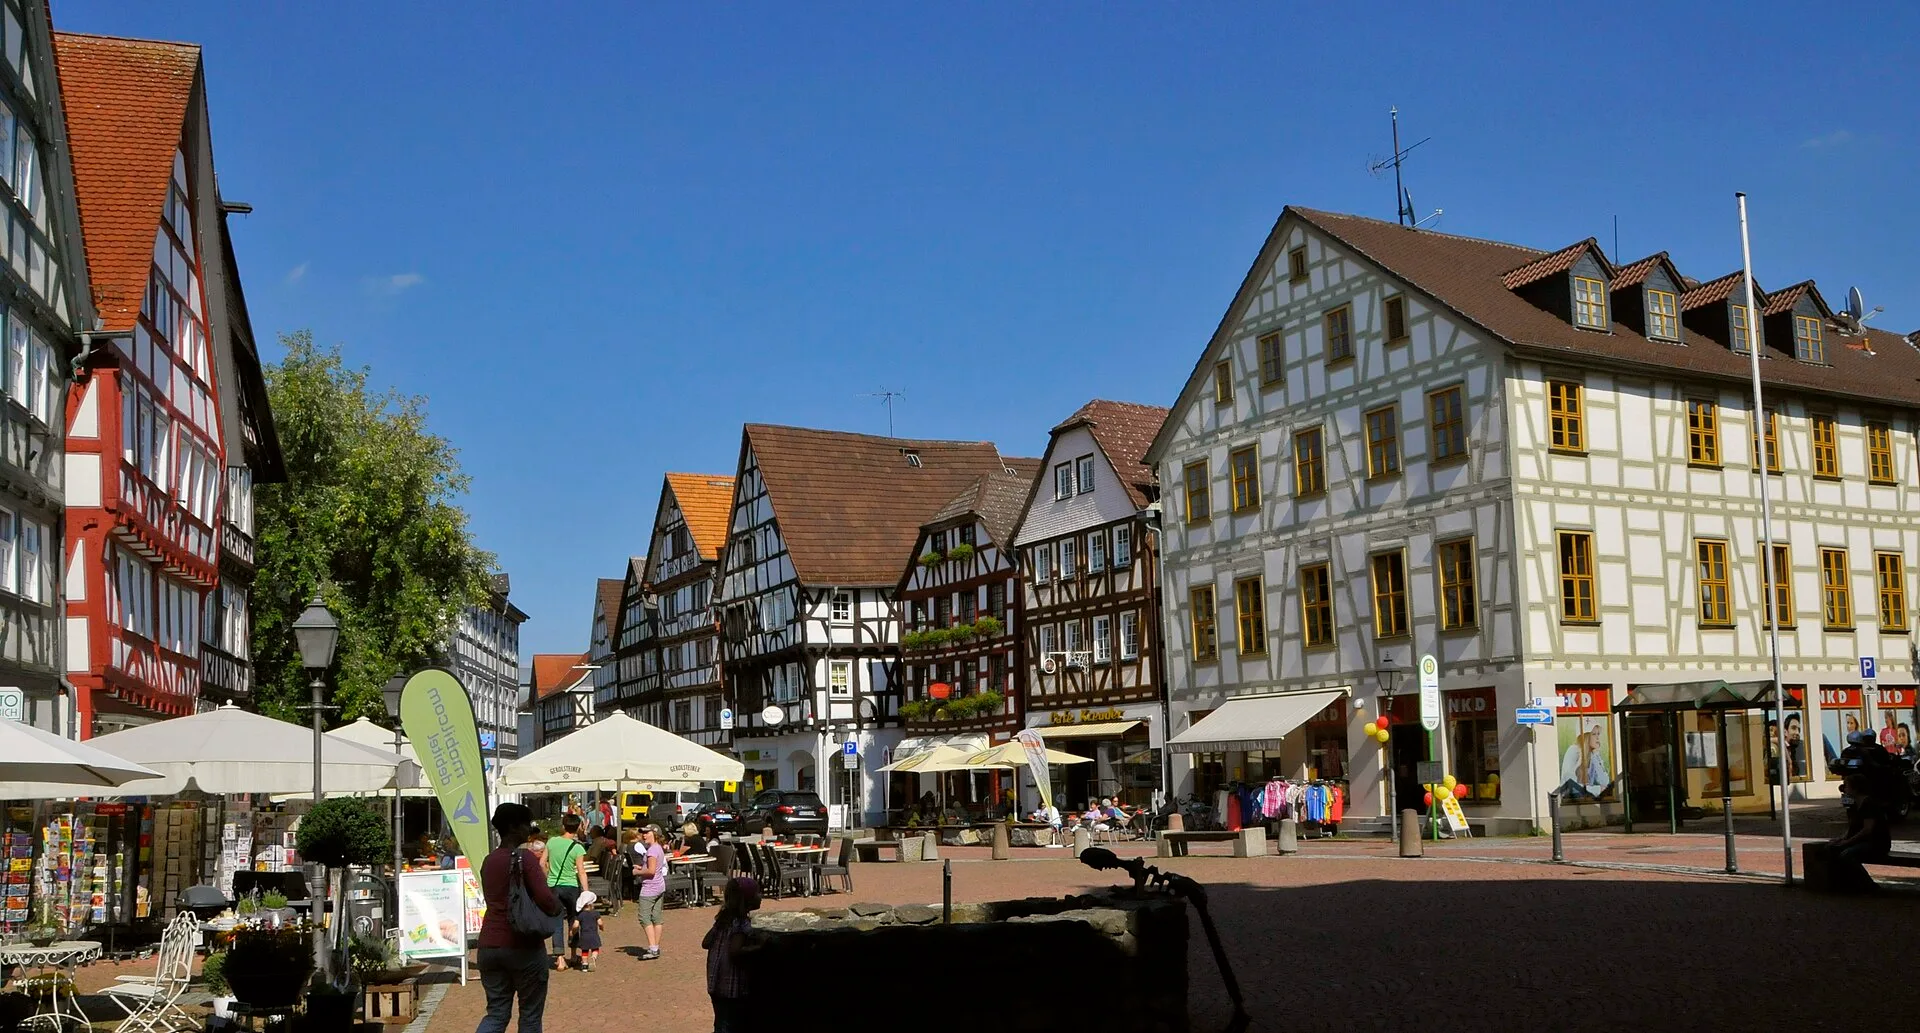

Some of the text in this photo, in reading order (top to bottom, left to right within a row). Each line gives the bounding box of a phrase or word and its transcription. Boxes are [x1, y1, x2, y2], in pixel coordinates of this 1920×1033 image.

[1863, 660, 1872, 676] P
[1448, 697, 1486, 713] NKD
[846, 743, 854, 753] P
[549, 765, 582, 775] GEROLSTEINER
[669, 764, 701, 773] GEROLSTEINER
